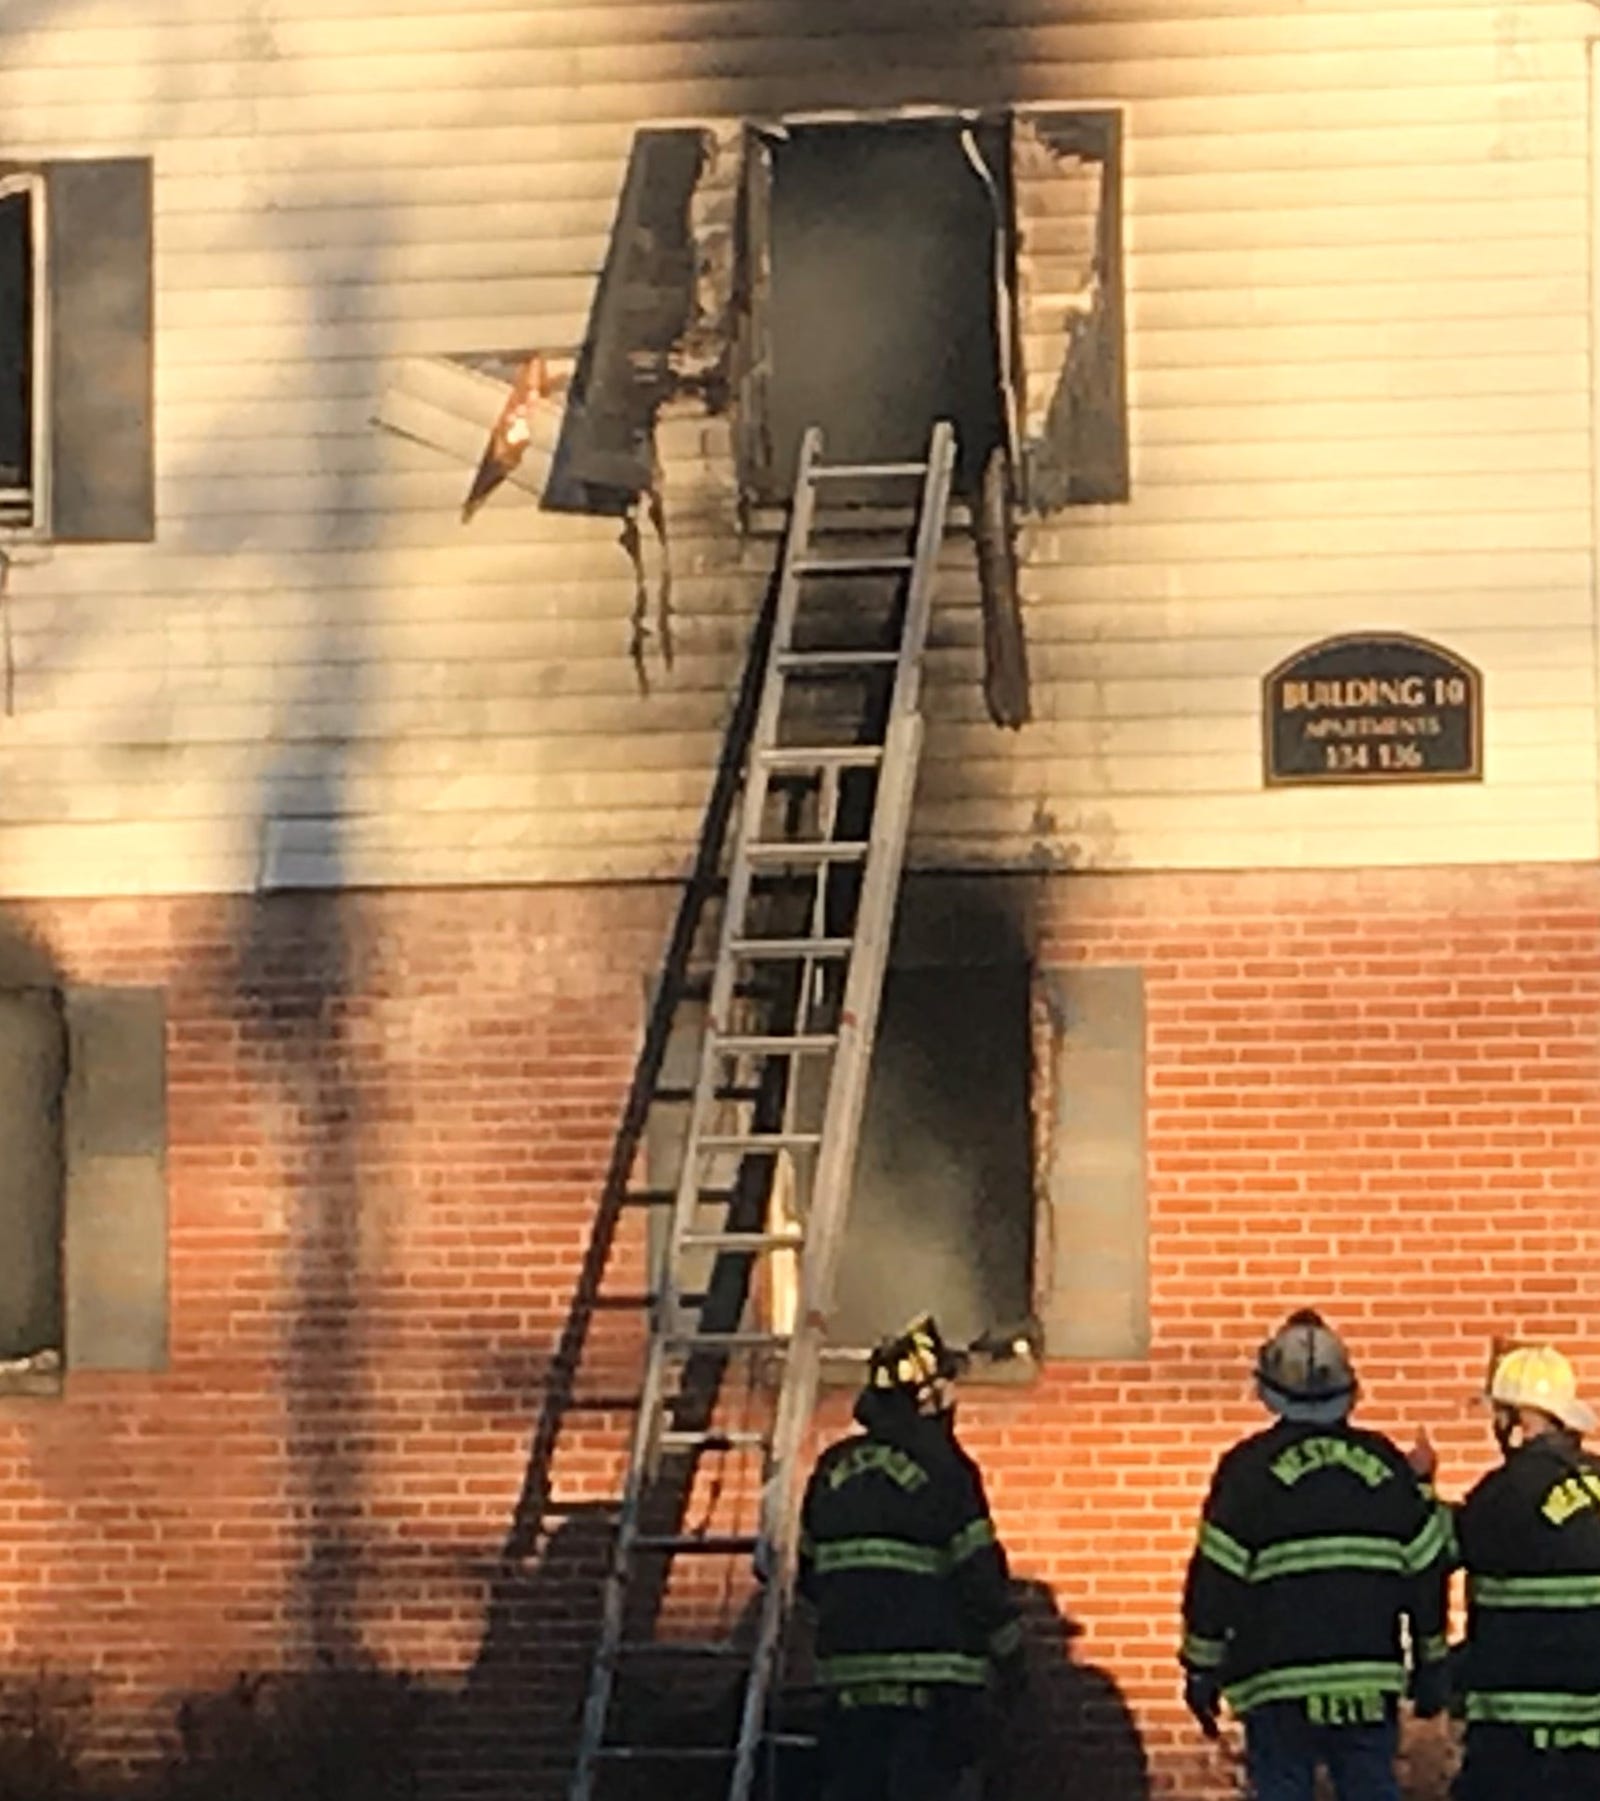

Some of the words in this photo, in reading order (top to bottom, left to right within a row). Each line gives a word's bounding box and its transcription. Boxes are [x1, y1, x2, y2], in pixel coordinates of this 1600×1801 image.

[1282, 676, 1426, 710] BUILDING
[1434, 677, 1465, 706] 10
[1303, 715, 1442, 738] APARTMENTS
[1326, 744, 1370, 769] 134
